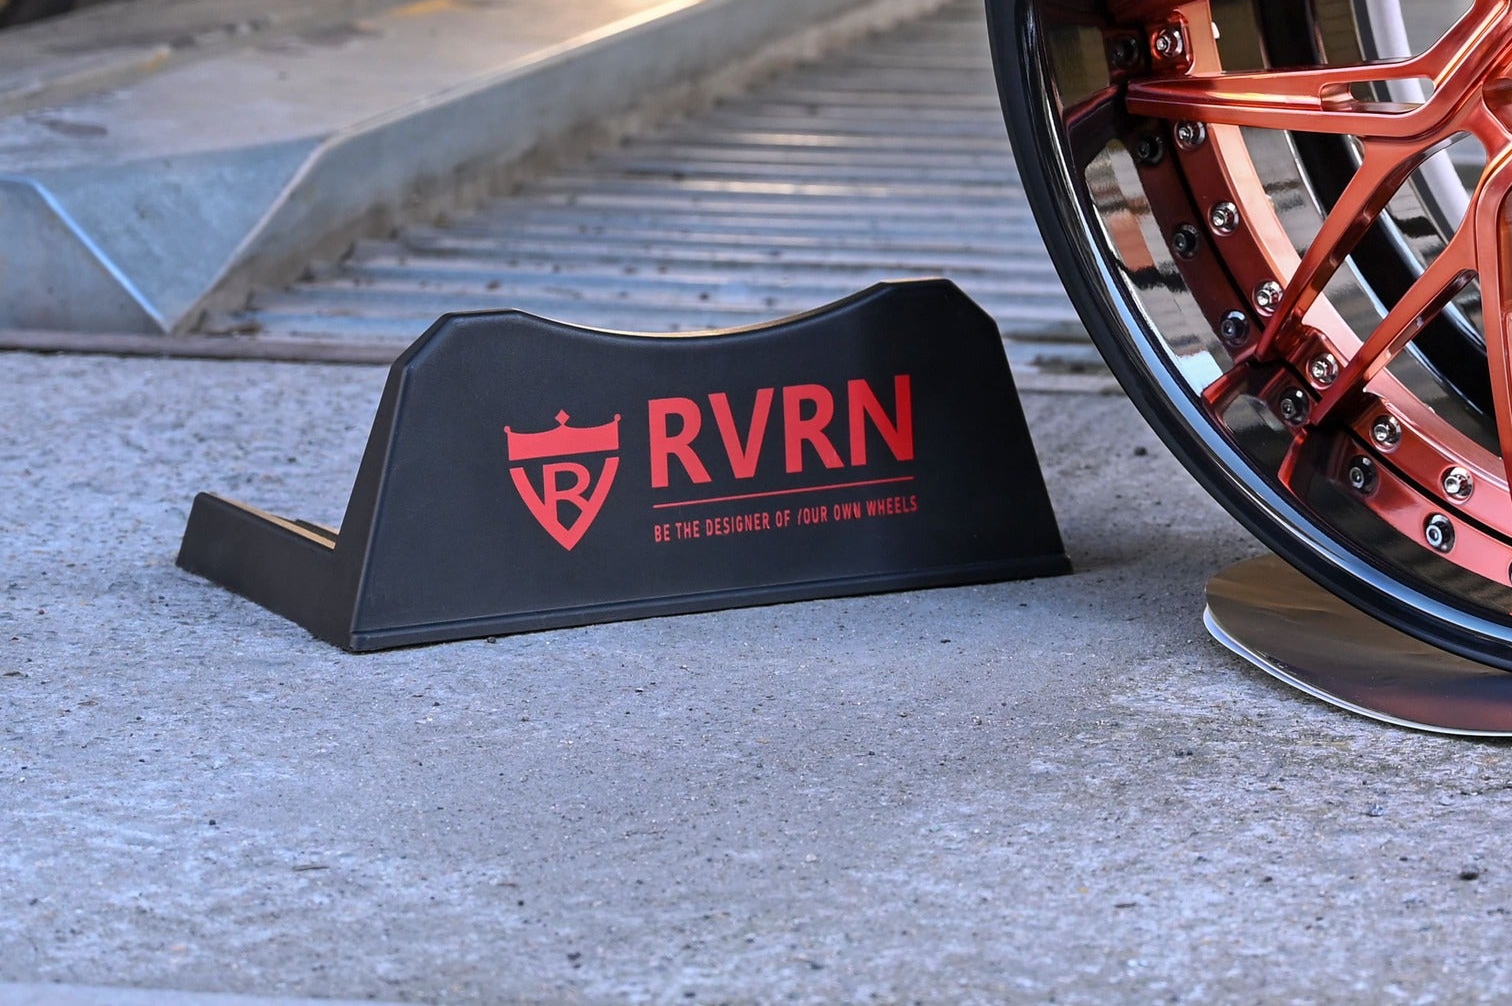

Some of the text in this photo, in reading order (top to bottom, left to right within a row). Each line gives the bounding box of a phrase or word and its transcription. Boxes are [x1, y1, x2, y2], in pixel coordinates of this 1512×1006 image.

[648, 374, 915, 488] RVRN
[654, 524, 671, 542] BE
[675, 520, 700, 540] THE
[705, 512, 770, 537] DESIGNER
[775, 509, 791, 528] OF
[833, 502, 861, 521] OWN
[866, 495, 918, 517] WHEELS
